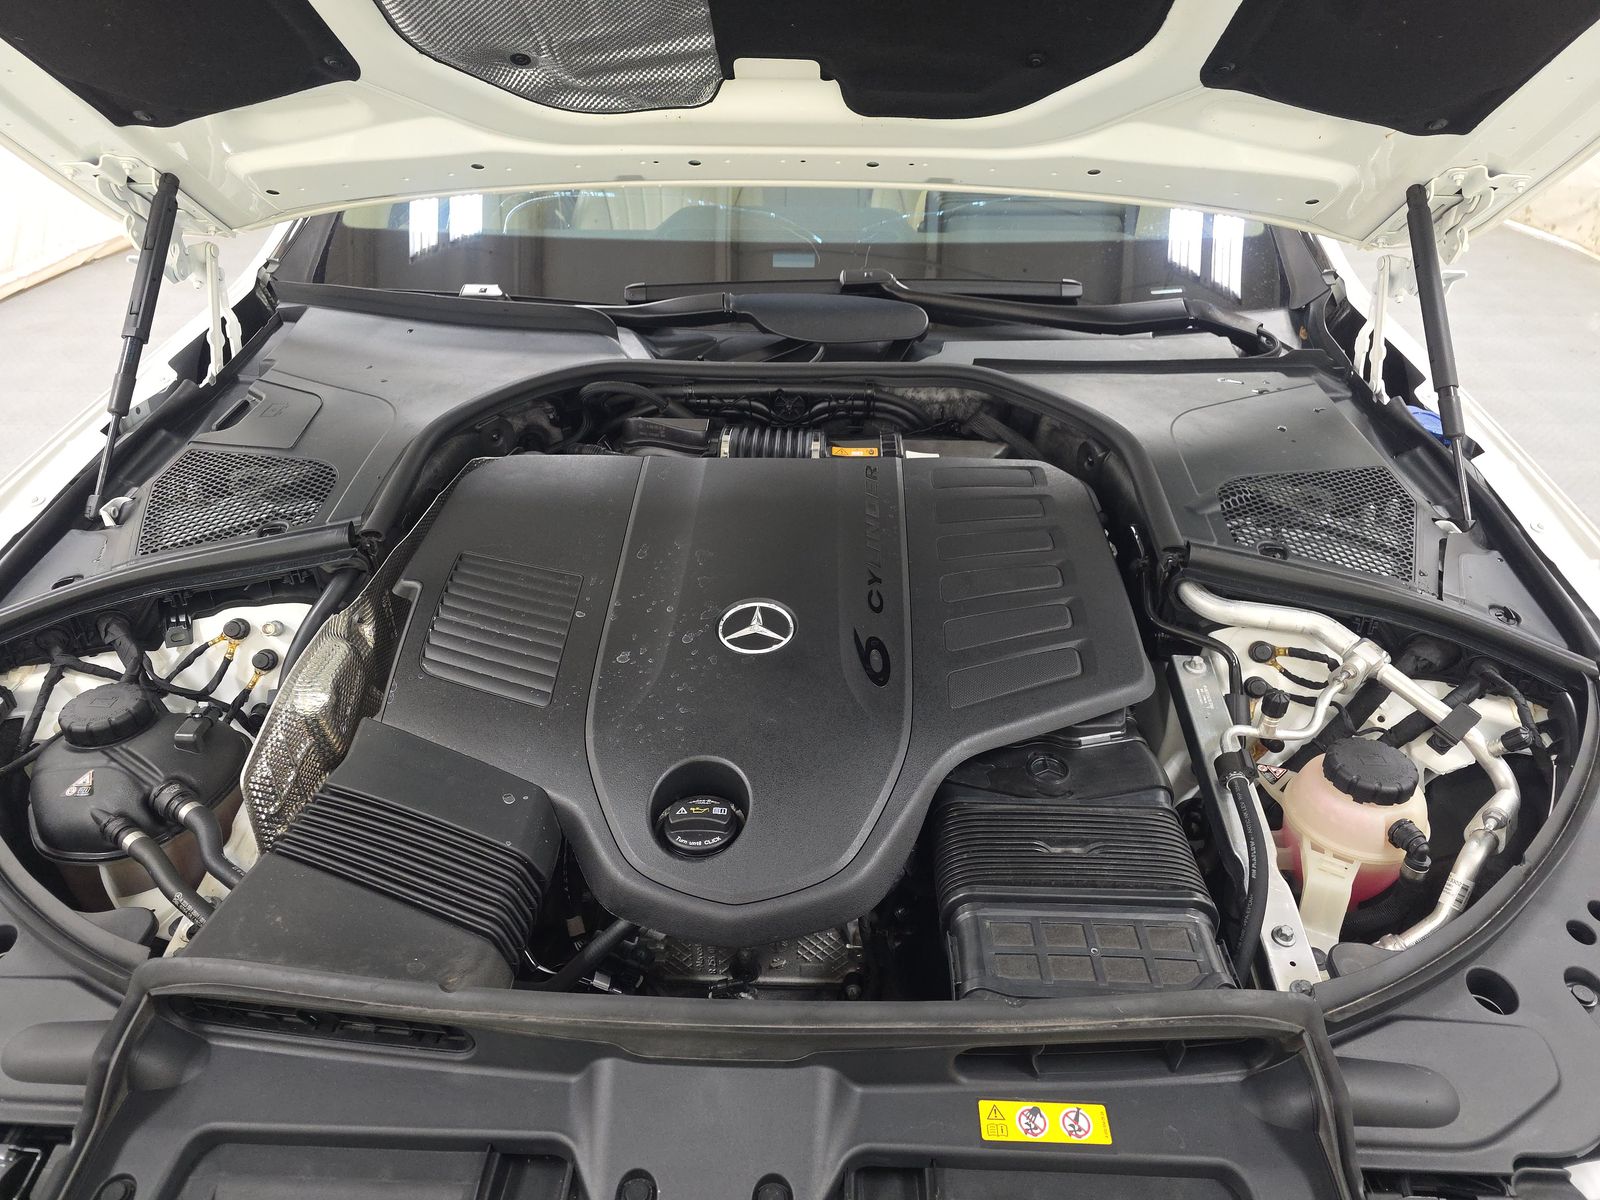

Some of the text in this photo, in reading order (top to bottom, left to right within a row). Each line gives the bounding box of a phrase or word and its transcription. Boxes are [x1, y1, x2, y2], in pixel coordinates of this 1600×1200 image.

[853, 464, 891, 688] 6 CYLINDER
[675, 835, 688, 845] Turn
[704, 835, 722, 845] CLICK
